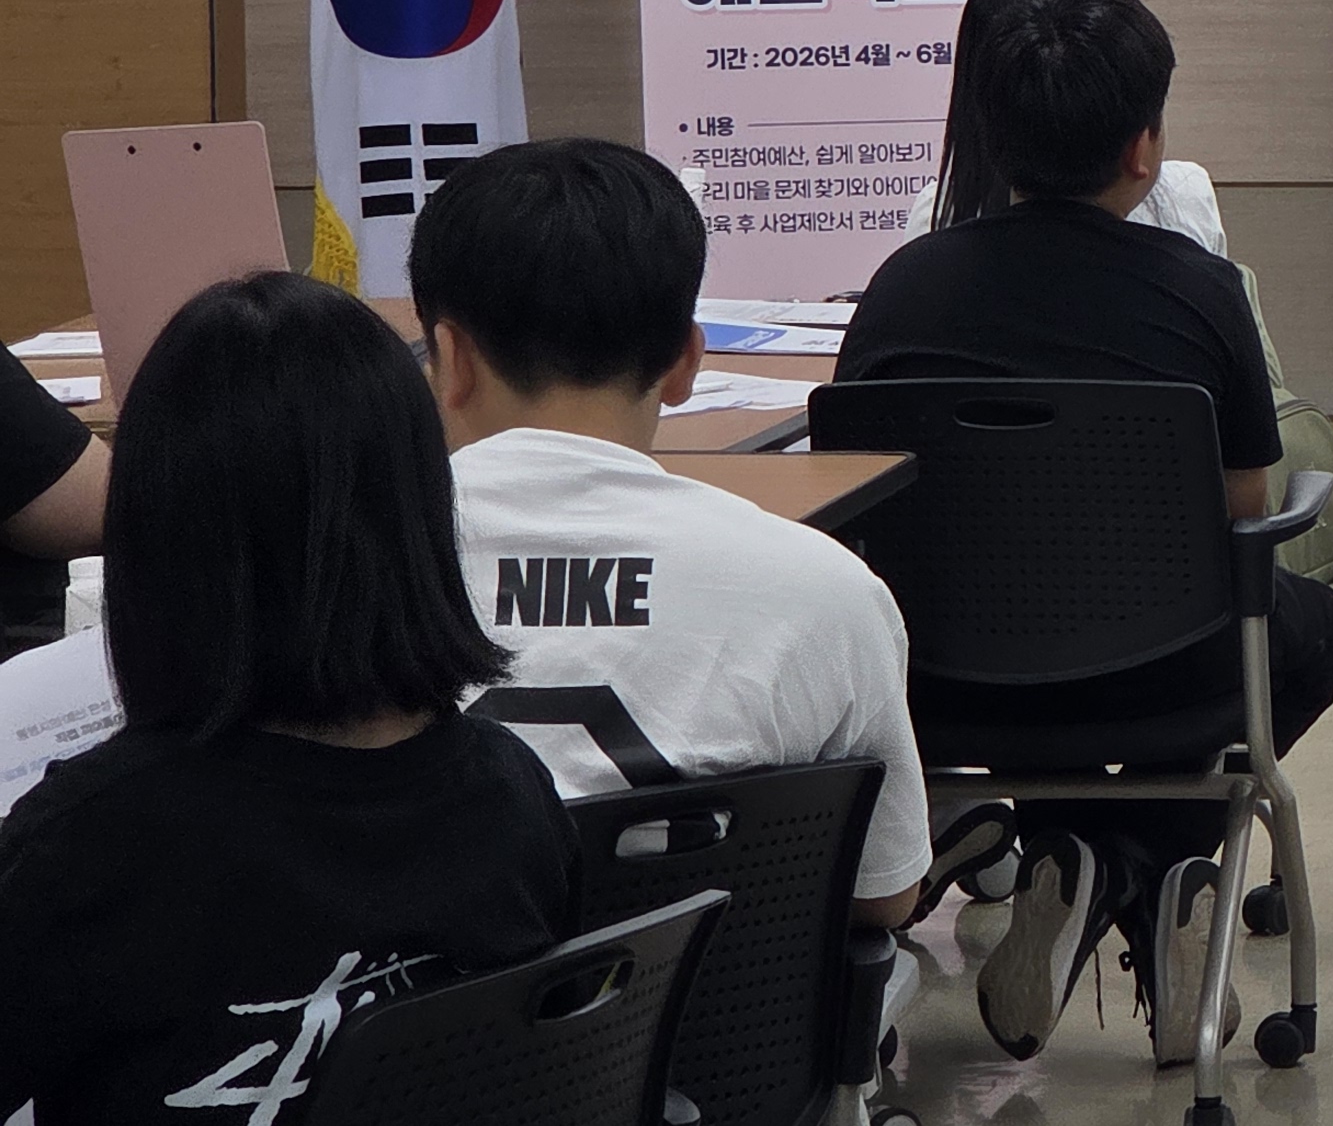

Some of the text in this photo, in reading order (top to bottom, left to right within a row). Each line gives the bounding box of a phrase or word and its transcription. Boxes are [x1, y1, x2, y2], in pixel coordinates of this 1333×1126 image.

[707, 48, 747, 70] 기간
[765, 45, 850, 67] 2026년
[855, 44, 890, 66] 4월
[917, 42, 951, 64] 6월
[697, 117, 734, 136] 내용
[691, 143, 931, 169] 주민참여예산, 쉽게 알아보기
[734, 181, 770, 200] 마을
[775, 179, 811, 199] 문제
[815, 178, 869, 198] 찾기와
[736, 214, 755, 234] 후
[760, 211, 853, 233] 사업제안서
[494, 558, 654, 627] NIKE
